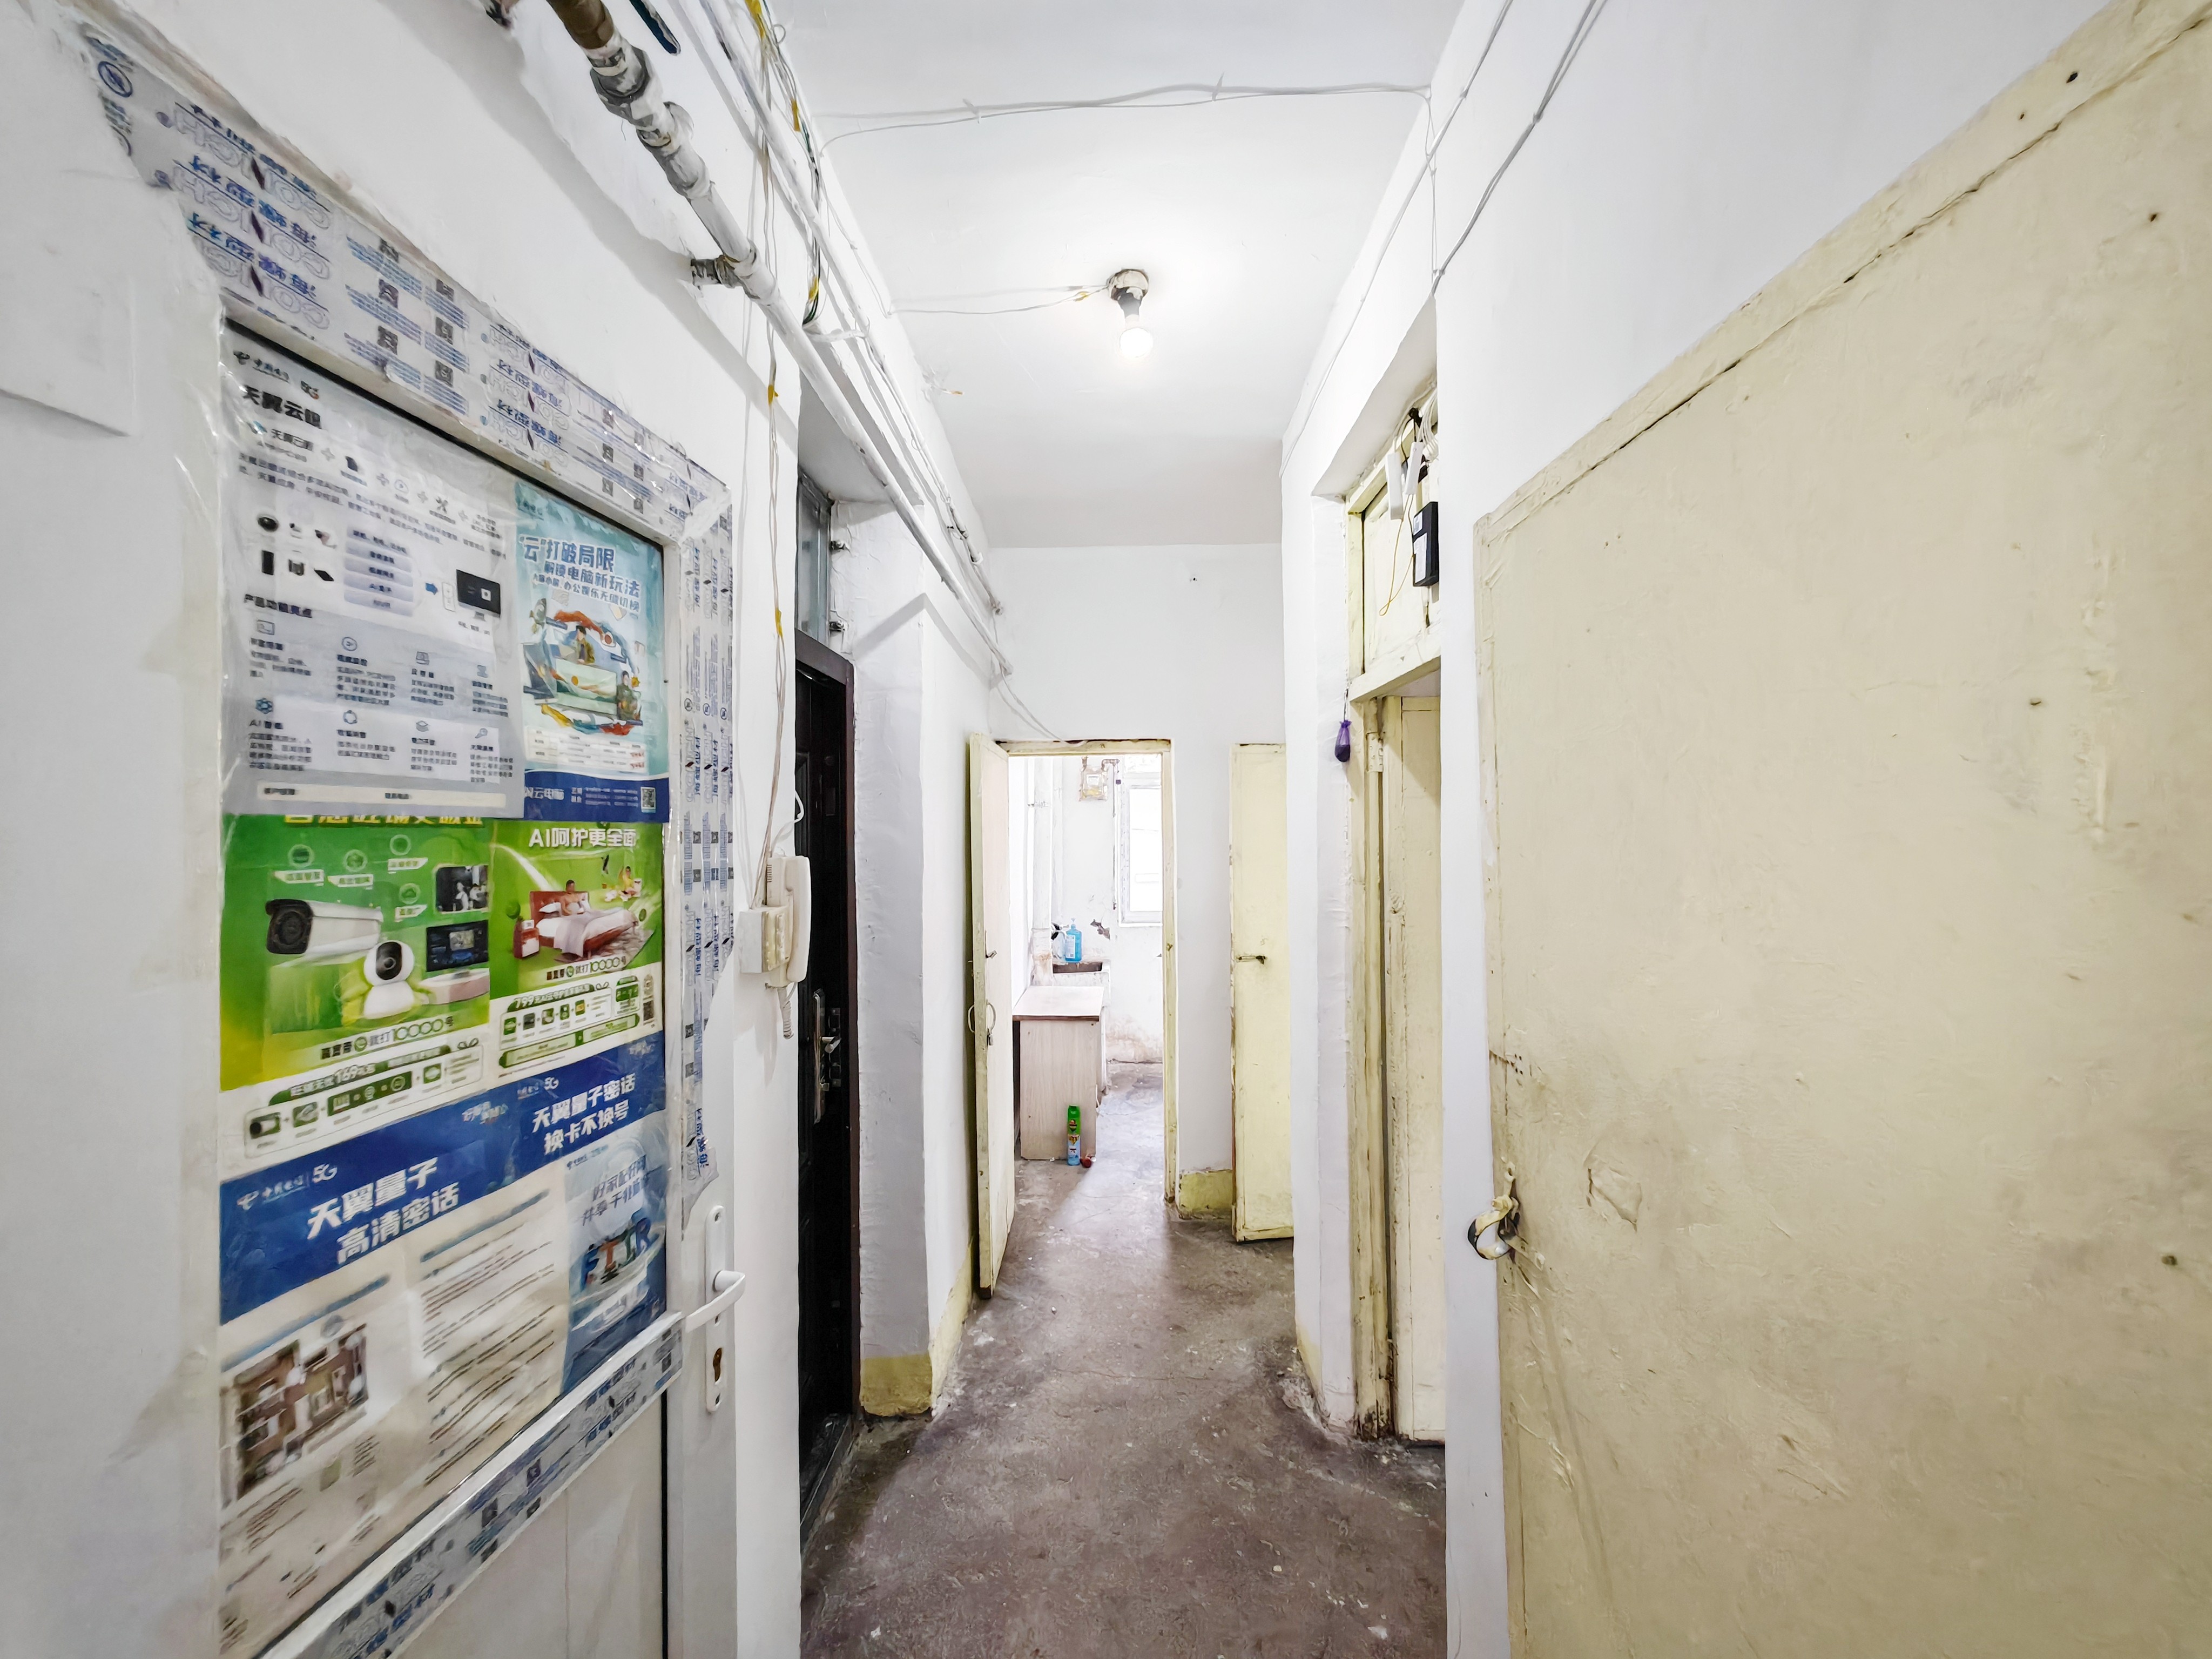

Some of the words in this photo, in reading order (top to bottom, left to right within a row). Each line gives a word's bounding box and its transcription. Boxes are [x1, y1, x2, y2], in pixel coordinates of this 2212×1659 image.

[529, 827, 638, 848] AI呵护更全面
[532, 1073, 636, 1134] 天翼量子密话
[544, 1098, 630, 1156] 换卡不换号
[306, 1156, 439, 1240] 天翼量子
[312, 1163, 338, 1183] 5G
[337, 1181, 460, 1265] 高清密话
